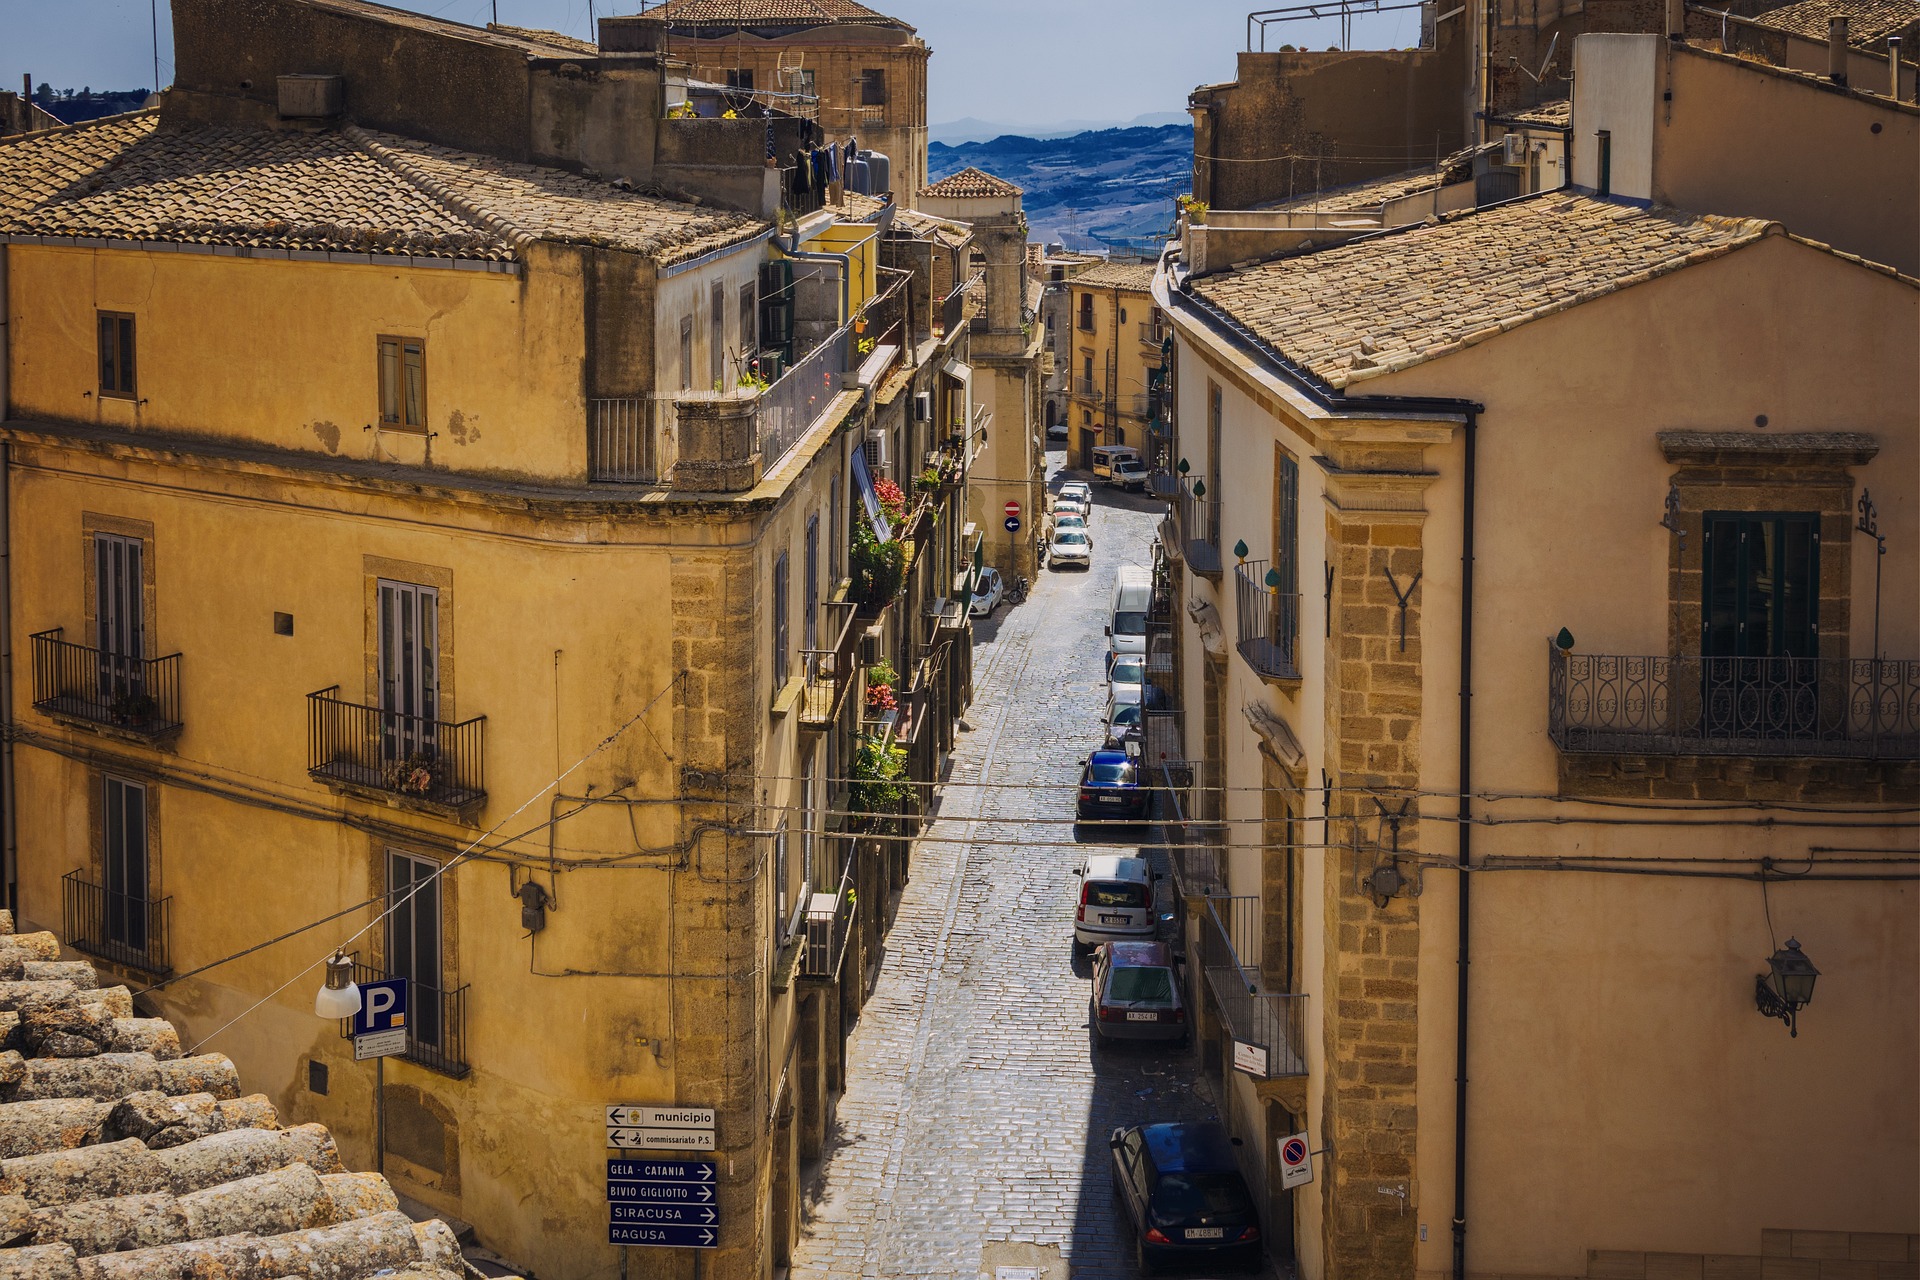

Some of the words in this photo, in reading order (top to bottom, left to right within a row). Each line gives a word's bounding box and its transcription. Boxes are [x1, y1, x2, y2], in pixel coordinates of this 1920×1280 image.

[366, 986, 396, 1028] P
[654, 1112, 711, 1124] municipio
[646, 1135, 695, 1145] commissariato
[698, 1136, 712, 1145] P.S.
[611, 1165, 633, 1175] GELA
[645, 1166, 685, 1176] CATANIA
[610, 1186, 637, 1197] BIVIO
[641, 1187, 688, 1198] GIGLIOTTO
[614, 1207, 682, 1220] SIRACUSA
[612, 1229, 666, 1240] RAGUSA
